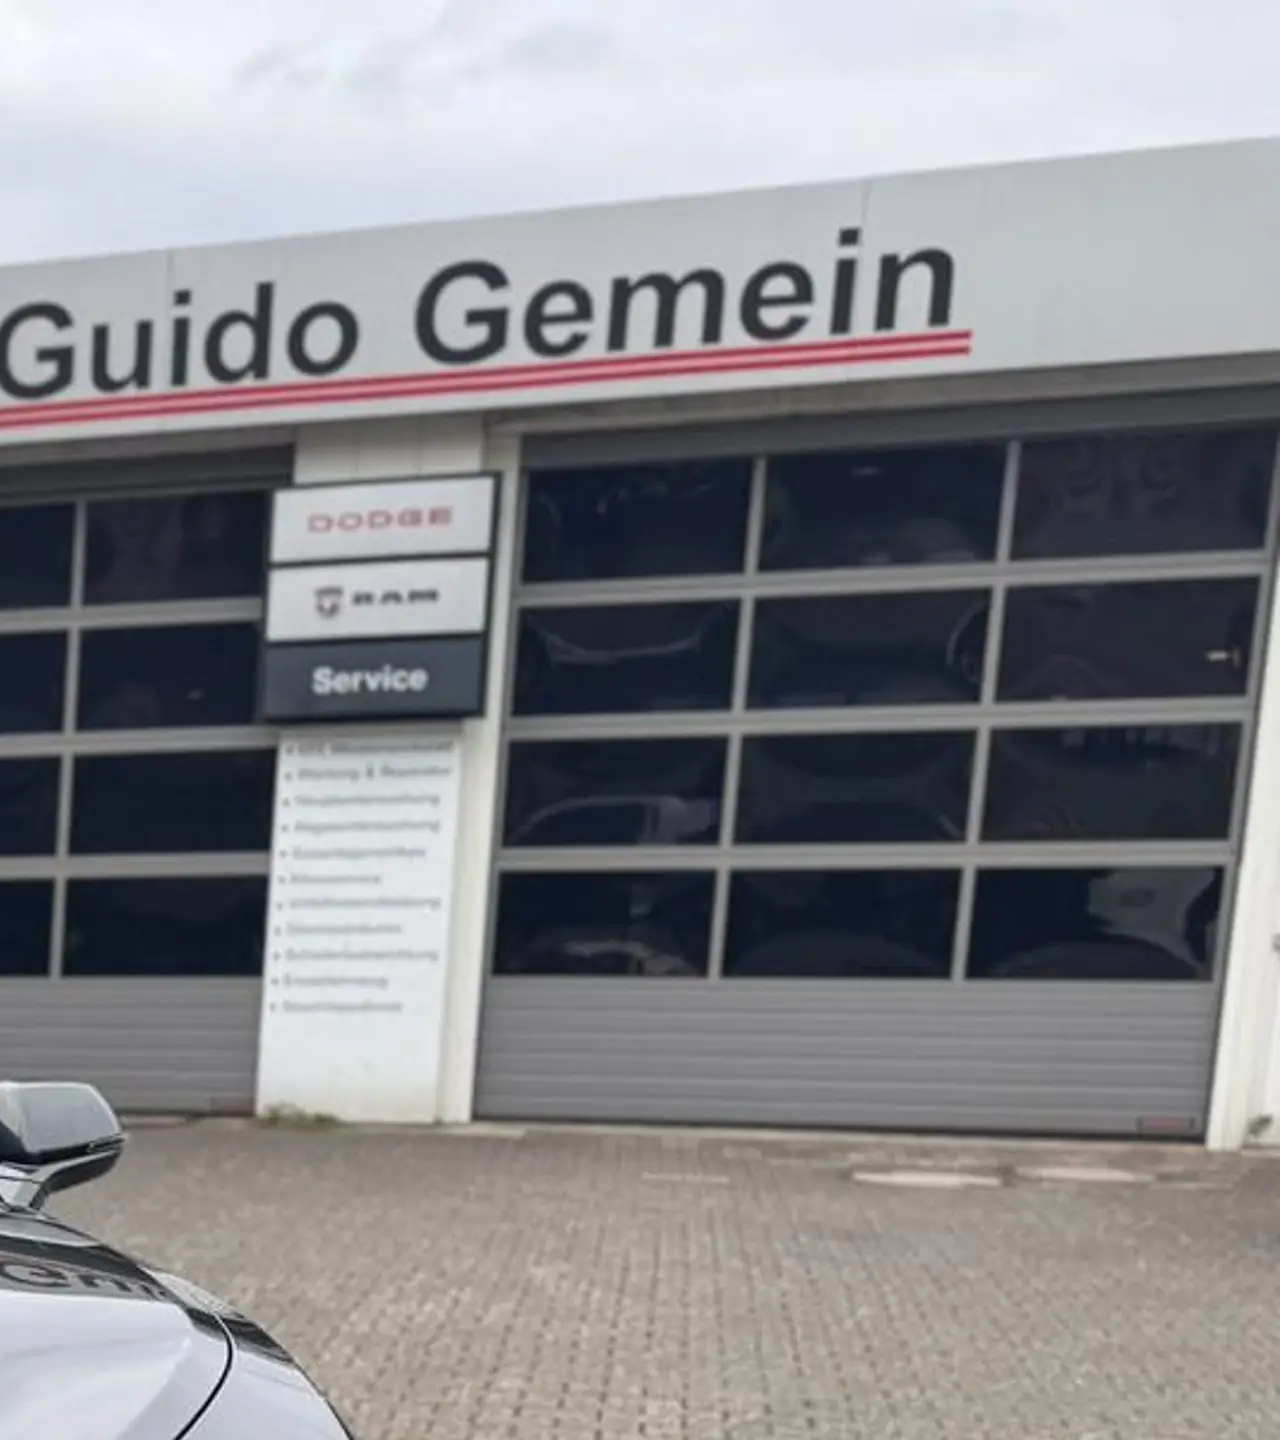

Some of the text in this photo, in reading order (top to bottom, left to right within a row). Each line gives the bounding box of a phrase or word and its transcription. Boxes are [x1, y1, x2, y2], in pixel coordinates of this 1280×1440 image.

[414, 226, 958, 368] Gemein
[308, 506, 452, 533] DODGE
[351, 587, 440, 607] RAM
[311, 664, 429, 695] Service
